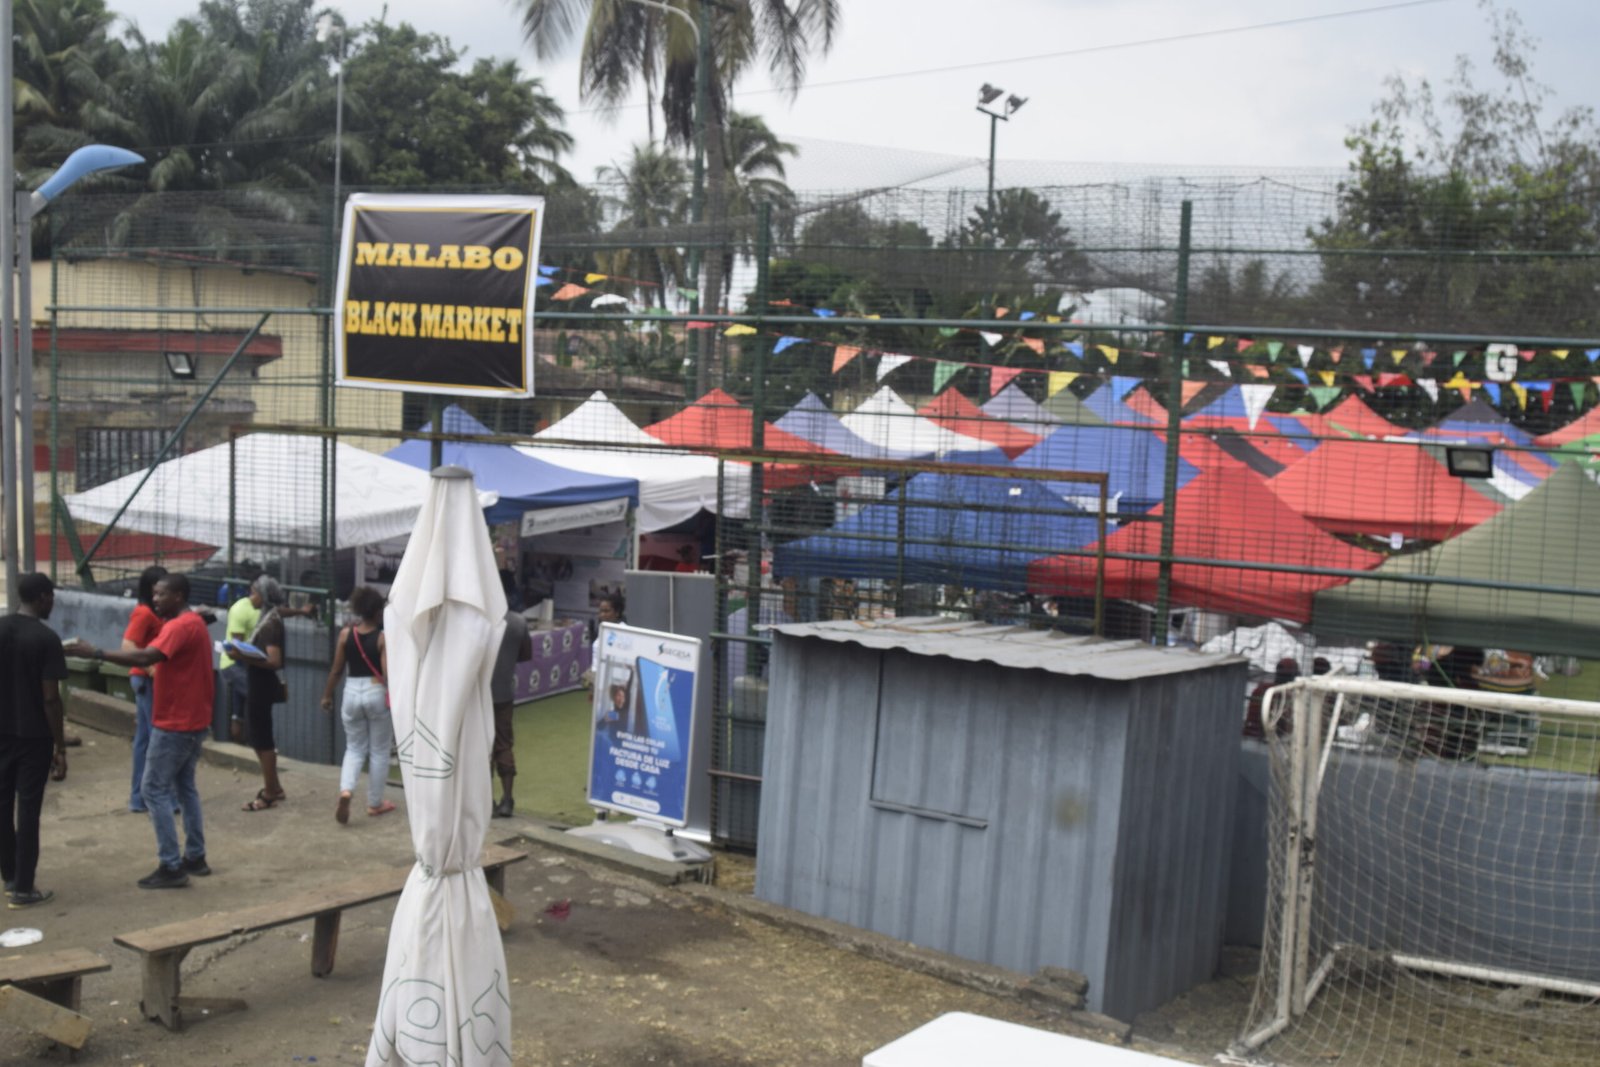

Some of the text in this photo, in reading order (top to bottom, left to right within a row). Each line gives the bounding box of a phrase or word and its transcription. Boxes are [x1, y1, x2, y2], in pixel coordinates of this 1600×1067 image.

[355, 241, 524, 272] MALABO
[345, 300, 523, 344] BLACK MARKET
[1485, 343, 1519, 382] G
[609, 746, 670, 769] FACTURA DE LUZ
[615, 757, 661, 775] DESDE CASA
